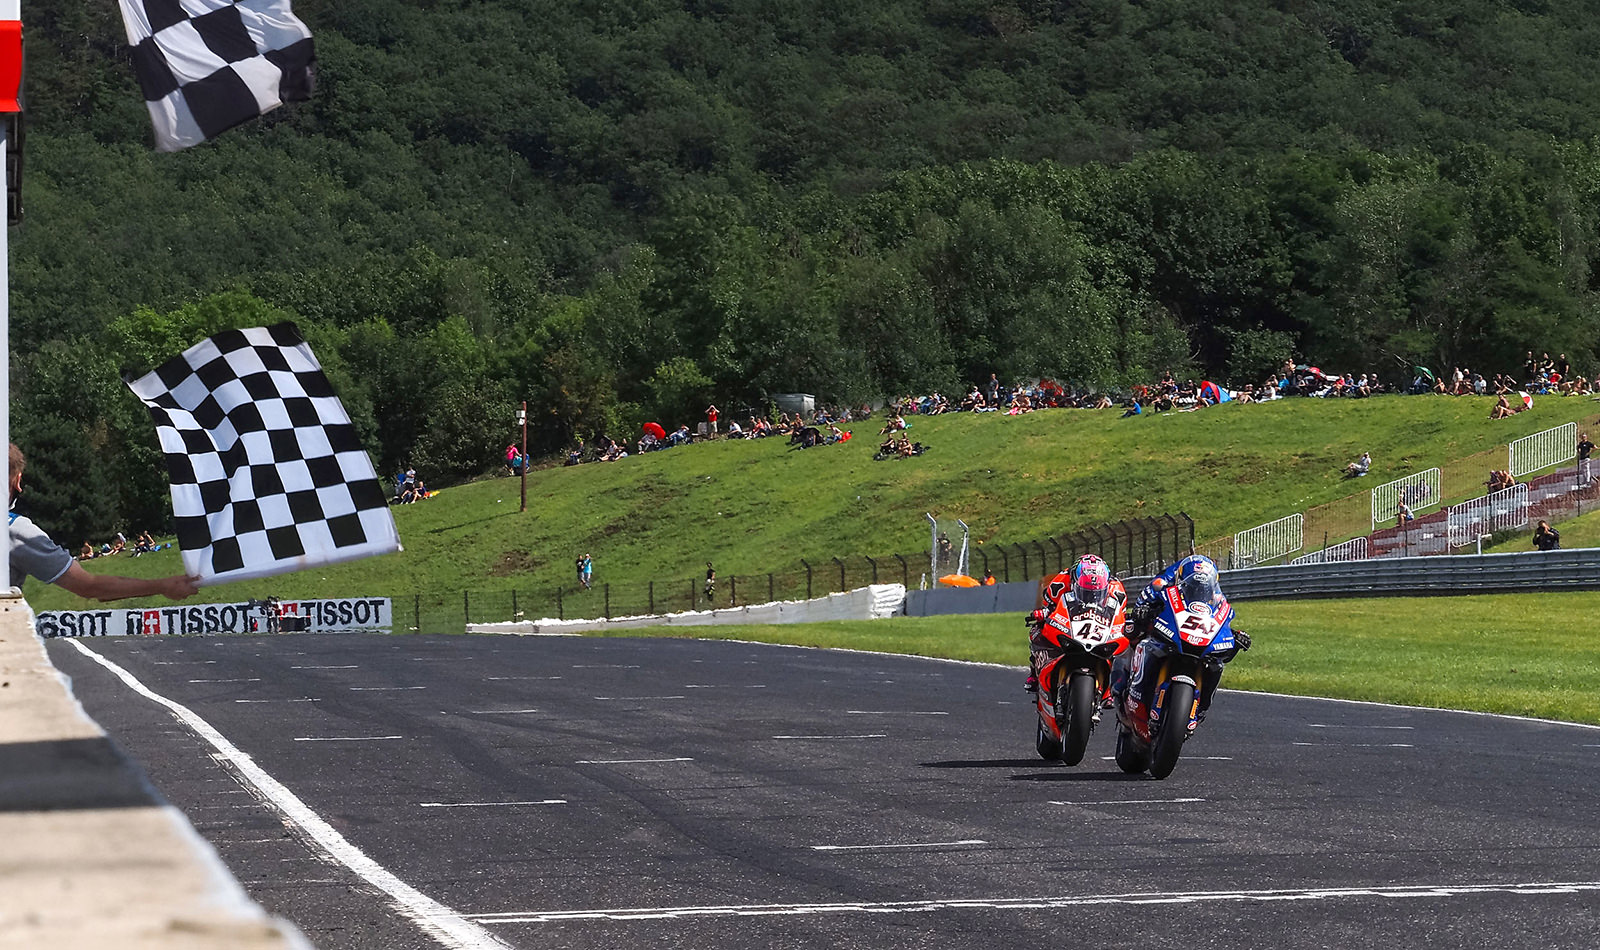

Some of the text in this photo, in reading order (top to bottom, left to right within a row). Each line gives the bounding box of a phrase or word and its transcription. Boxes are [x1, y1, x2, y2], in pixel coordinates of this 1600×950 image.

[162, 605, 254, 634] TISSOT
[300, 600, 385, 627] TISSOT
[1049, 619, 1070, 634] Lenovo
[1077, 623, 1106, 642] 45
[1154, 621, 1175, 638] YAMAHA
[1213, 642, 1234, 650] YAMAHA
